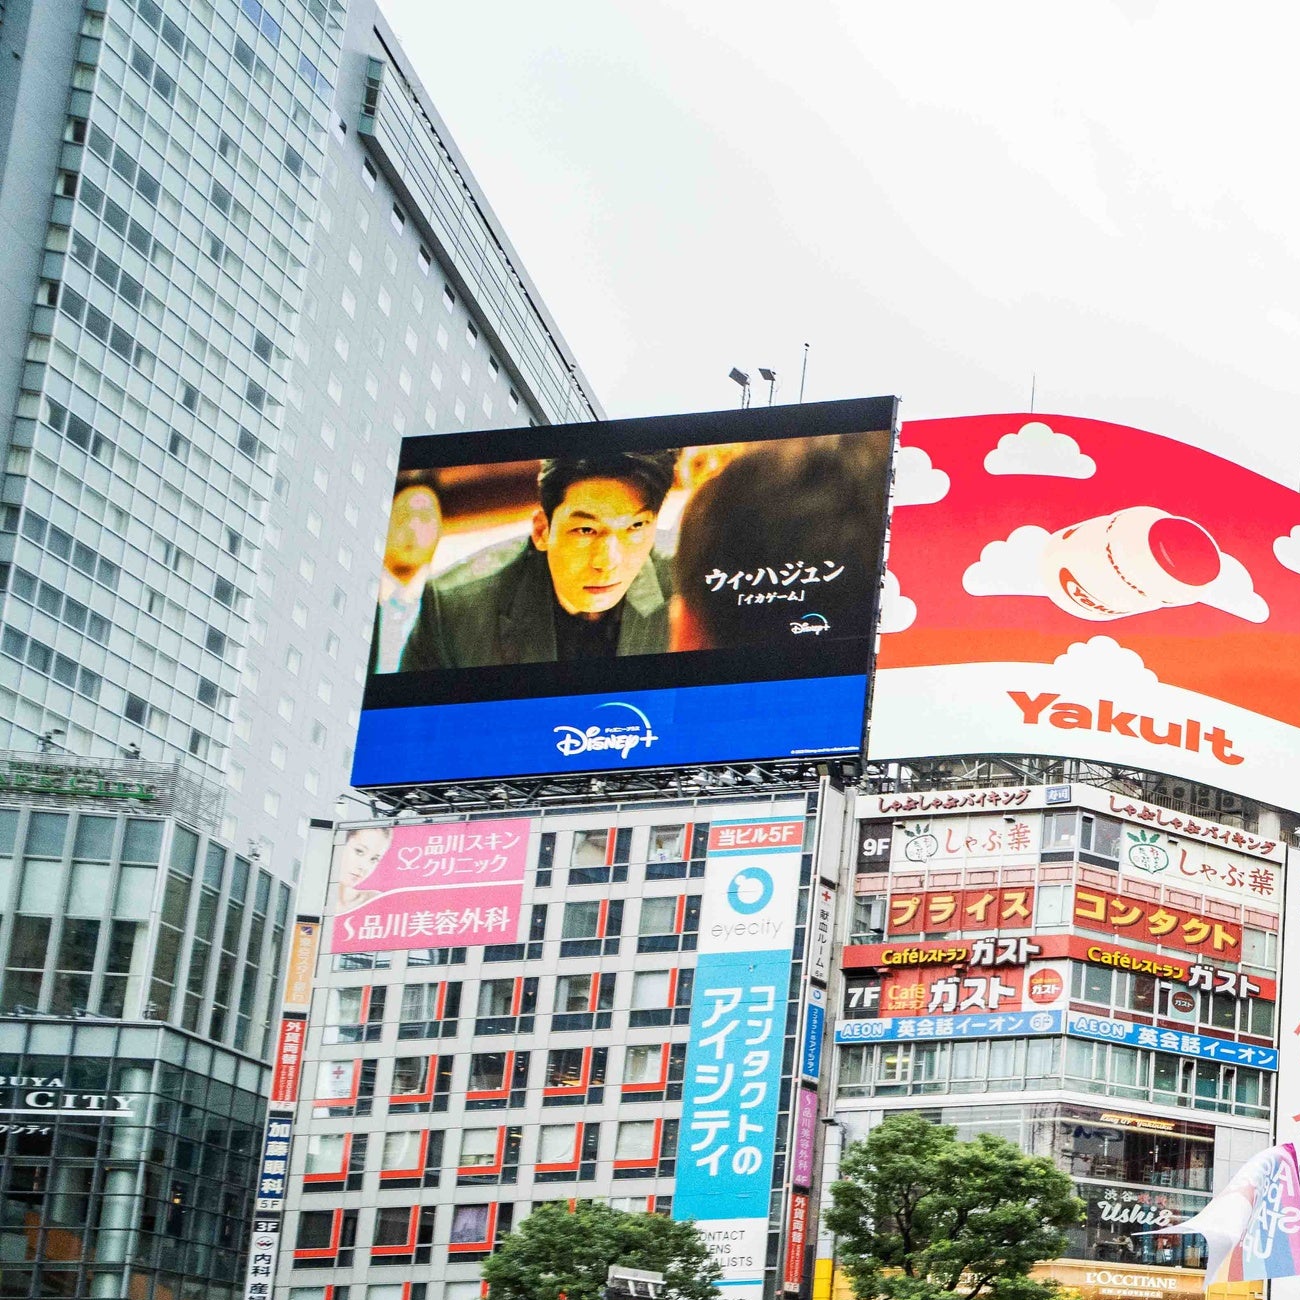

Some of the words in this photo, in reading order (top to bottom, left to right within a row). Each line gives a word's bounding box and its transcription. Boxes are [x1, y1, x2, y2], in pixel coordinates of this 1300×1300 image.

[705, 559, 845, 592] ウィ・ハジュン
[553, 725, 659, 760] Disney+
[1006, 690, 1244, 766] Yakult
[878, 789, 1032, 813] しゃぶしゃぶバイキング
[717, 824, 794, 847] 当ビル5F
[945, 822, 1031, 854] しゃぶ葉
[1110, 795, 1277, 855] しゃぶしゃぶバイキング
[424, 830, 522, 856] 品川スキン
[863, 837, 890, 857] 9F
[422, 852, 509, 879] クリニック
[1179, 848, 1275, 896] しゃぶ葉
[891, 890, 1033, 926] プライス
[1076, 890, 1240, 952] コンタクト
[359, 907, 511, 941] 品川美容外科
[710, 918, 783, 941] eyecity
[816, 909, 830, 969] 献血ルーム
[970, 937, 1040, 966] ガスト
[888, 983, 926, 1000] Café
[928, 977, 1016, 1014] ガスト
[1189, 963, 1264, 998] ガスト
[848, 986, 880, 1008] 7F
[842, 1023, 884, 1038] AEON
[897, 1016, 1024, 1038] 英会話イーオン
[1074, 1019, 1125, 1040] AEON
[1137, 1030, 1275, 1066] 英会話イーオン
[690, 986, 743, 1177] アイシティ
[731, 985, 776, 1176] コンタクトの
[25, 1091, 138, 1110] CITY
[260, 1120, 290, 1195] 加藤眼科
[256, 1221, 279, 1232] 3F
[700, 1230, 745, 1241] ONTACT
[708, 1244, 731, 1255] ENS
